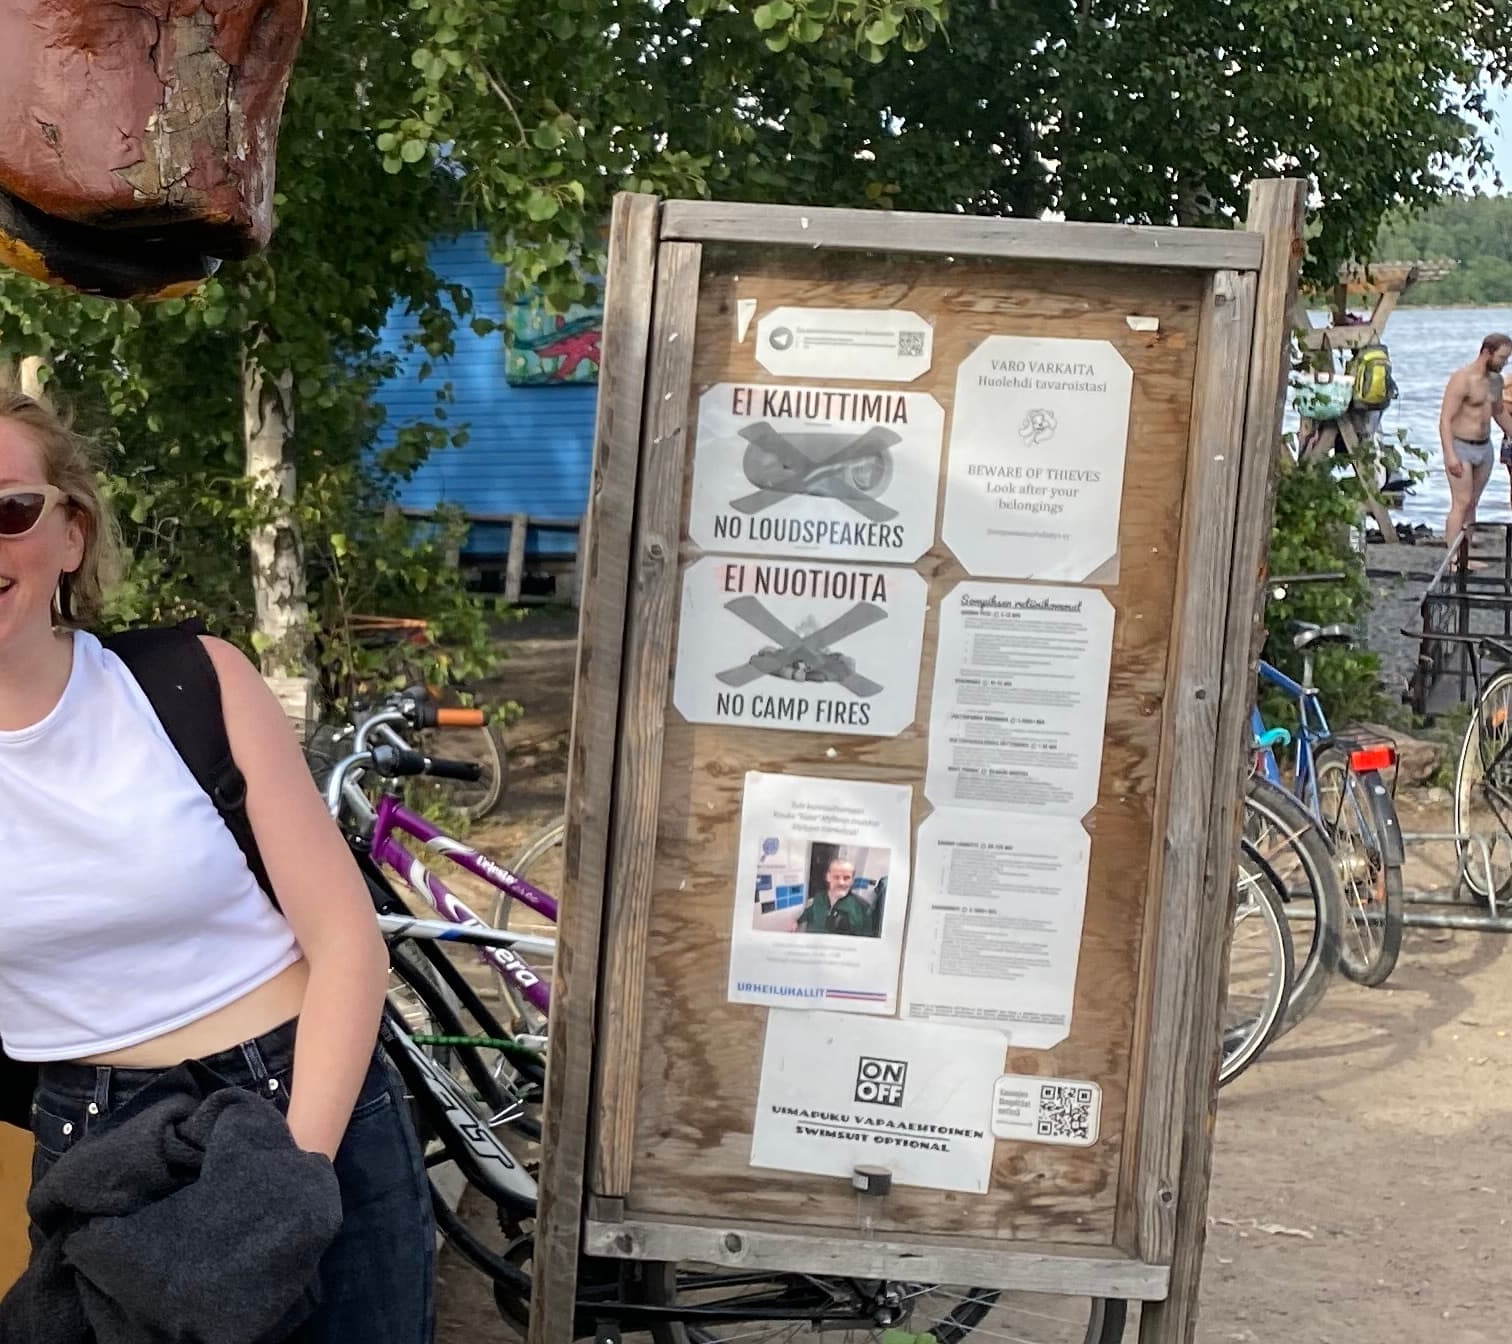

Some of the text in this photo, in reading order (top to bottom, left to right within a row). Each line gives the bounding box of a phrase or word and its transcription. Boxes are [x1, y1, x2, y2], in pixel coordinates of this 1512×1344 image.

[991, 359, 1095, 376] VARO VARKAITA
[978, 374, 1107, 392] Huolehdi tavaroistasi
[732, 388, 908, 425] EI KAIUTTIMIA
[968, 464, 1102, 483] BEWARE OF THIEVES
[986, 481, 1080, 500] Look after your
[998, 498, 1064, 515] belongings
[714, 515, 904, 549] NO LOUDSPEAKERS
[724, 564, 887, 602] EI NUOTIOITA
[716, 693, 871, 725] NO CAMP FIRES
[737, 982, 825, 998] URHEILUHALLIT
[862, 1061, 903, 1082] ON
[857, 1081, 903, 1105] OFF
[772, 1105, 850, 1124] UIMAPUKU
[854, 1116, 985, 1140] VAPAAEHTOINEN
[795, 1125, 950, 1153] SWIMSUIT OPTIONAL
